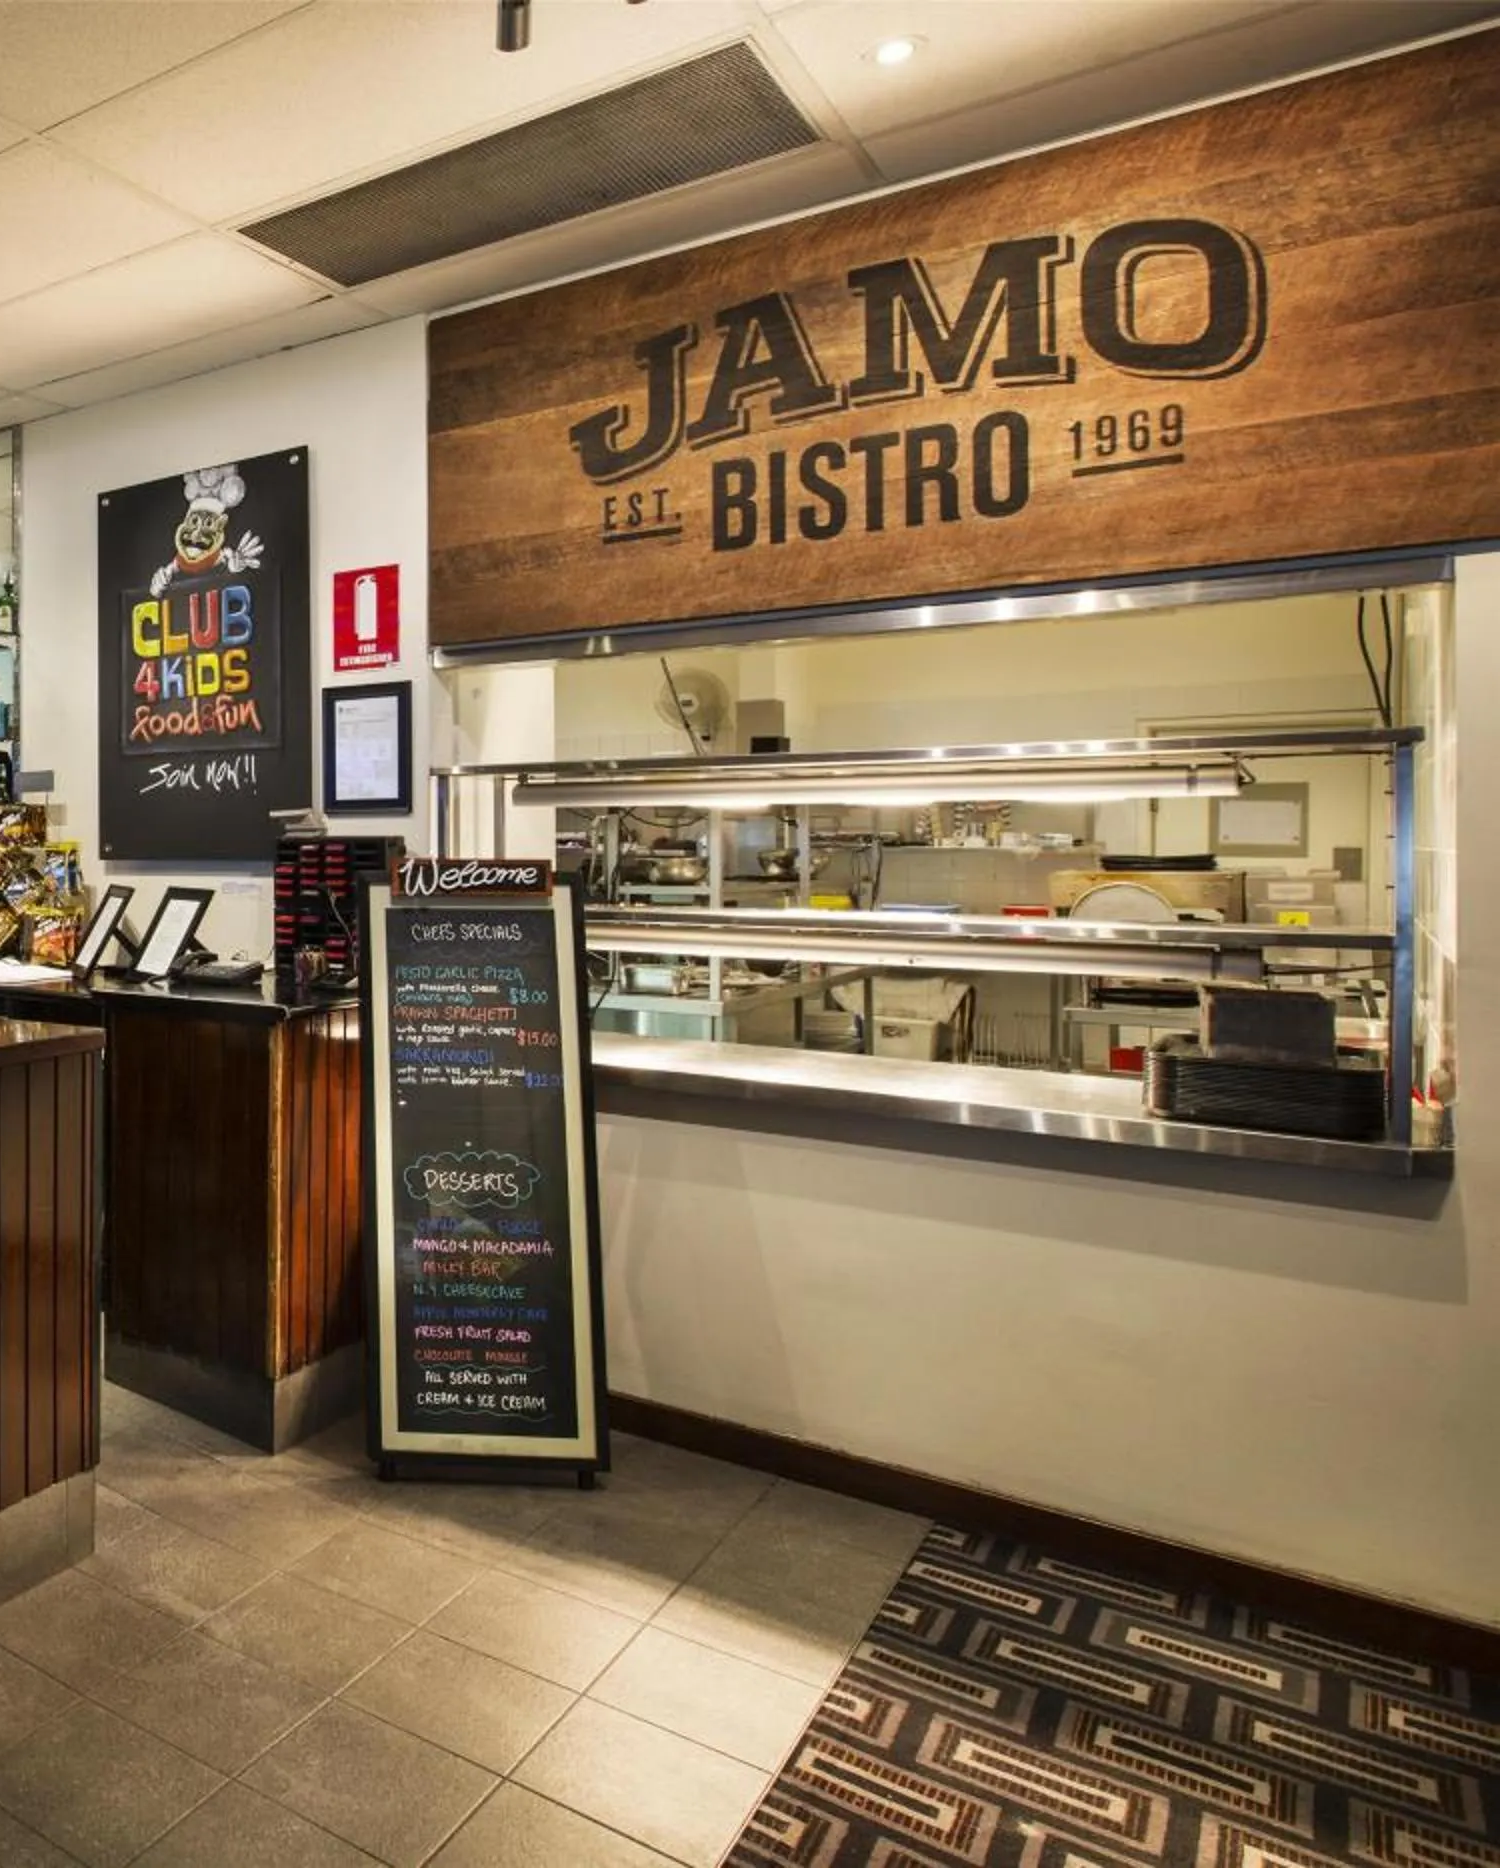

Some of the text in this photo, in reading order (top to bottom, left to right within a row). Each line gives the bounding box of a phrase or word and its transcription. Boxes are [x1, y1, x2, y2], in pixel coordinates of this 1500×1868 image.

[568, 218, 1267, 485] JAMO
[604, 403, 1185, 552] EST. BISTRO 1969
[131, 584, 255, 659] CLUB
[139, 762, 201, 793] Join
[399, 859, 538, 896] Welcome
[459, 922, 522, 941] SPECIALS
[434, 964, 480, 979] GARLIC
[483, 964, 524, 985] PIZZA
[508, 987, 549, 1005] $8.00
[393, 1005, 517, 1023] PRAWN SPAGHETTI
[423, 1169, 519, 1197] DESSERTS
[412, 1238, 457, 1254] MANGO
[473, 1239, 554, 1258] MACADAMIA
[442, 1283, 526, 1300] CHEESECAKE
[414, 1325, 533, 1343] FRESH FRUIT SALAD
[448, 1370, 492, 1385] SERVED
[415, 1391, 460, 1405] CREAM
[477, 1393, 497, 1408] ICE
[500, 1395, 547, 1411] CREAM
